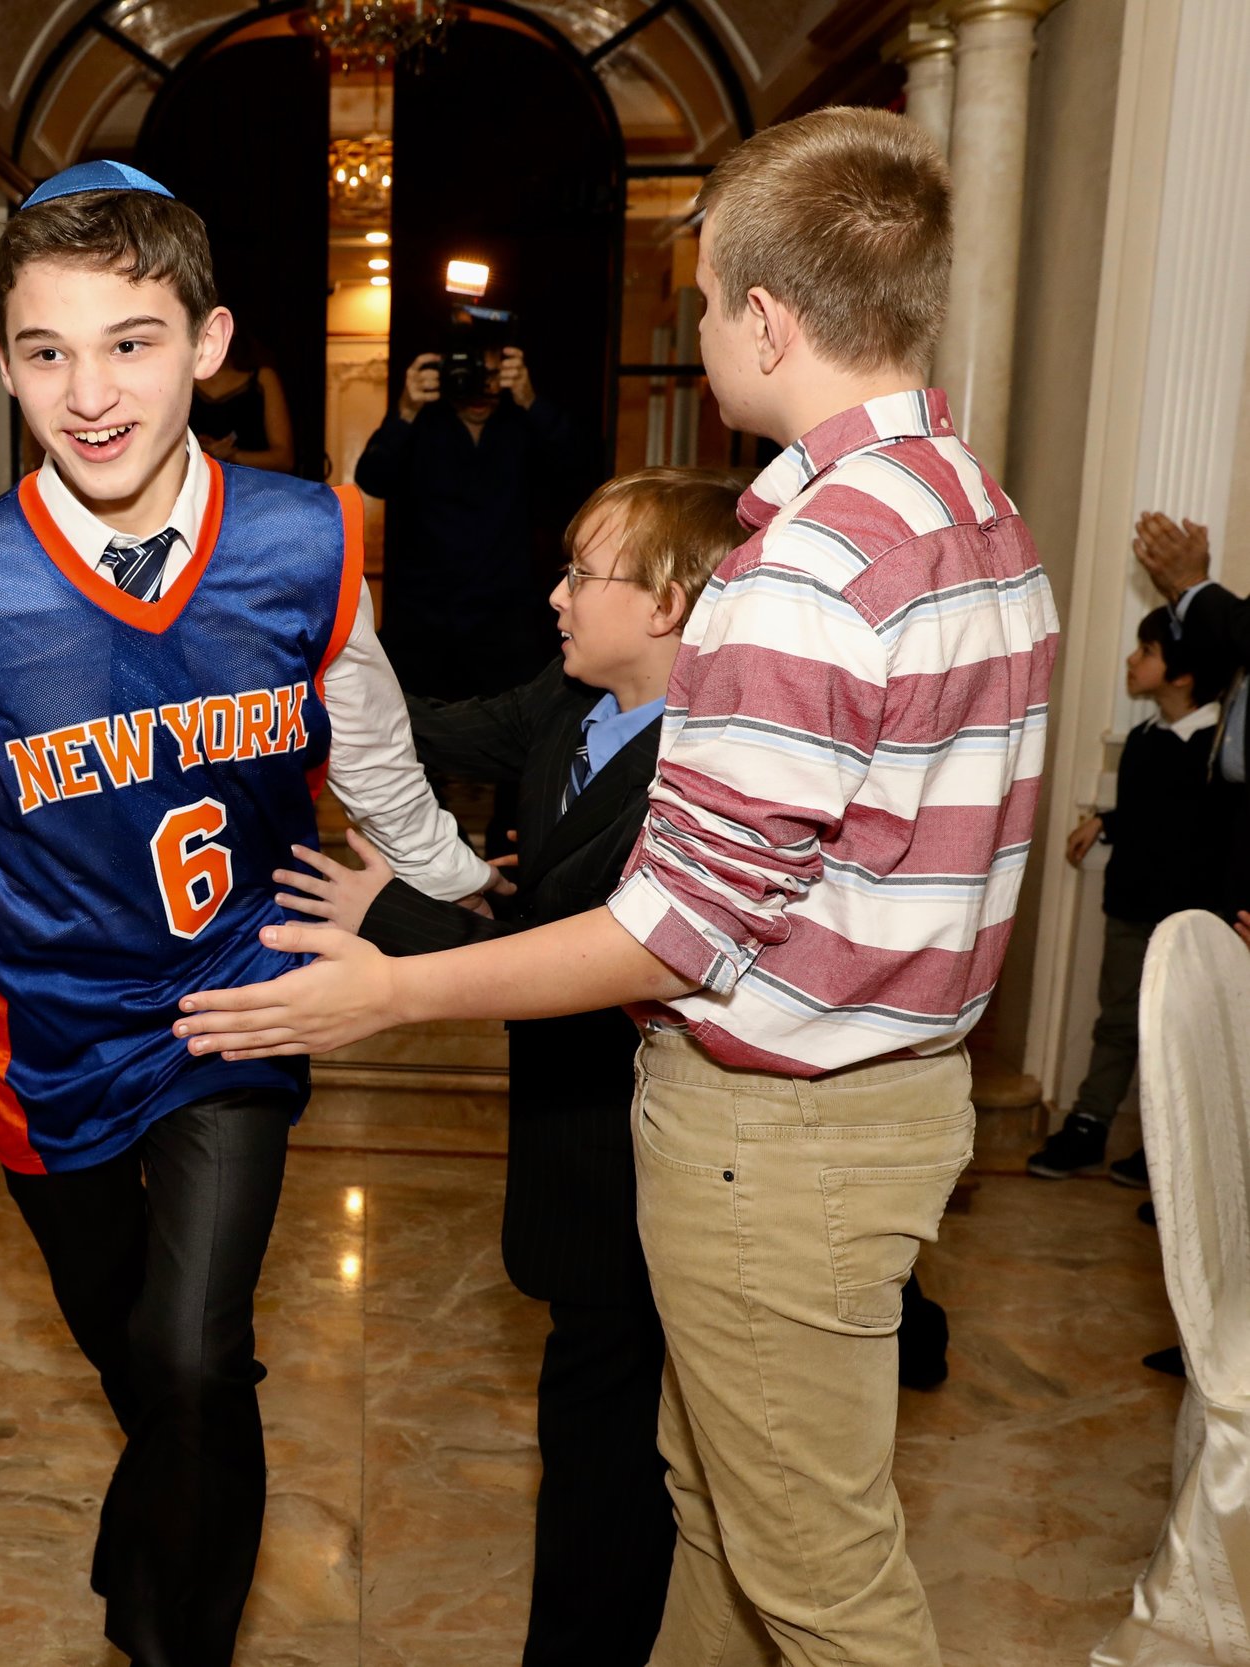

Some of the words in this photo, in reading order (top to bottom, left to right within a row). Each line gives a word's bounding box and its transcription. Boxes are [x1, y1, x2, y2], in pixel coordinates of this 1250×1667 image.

[5, 708, 157, 814] NEW
[159, 681, 309, 772] YORK
[150, 796, 233, 940] 6
